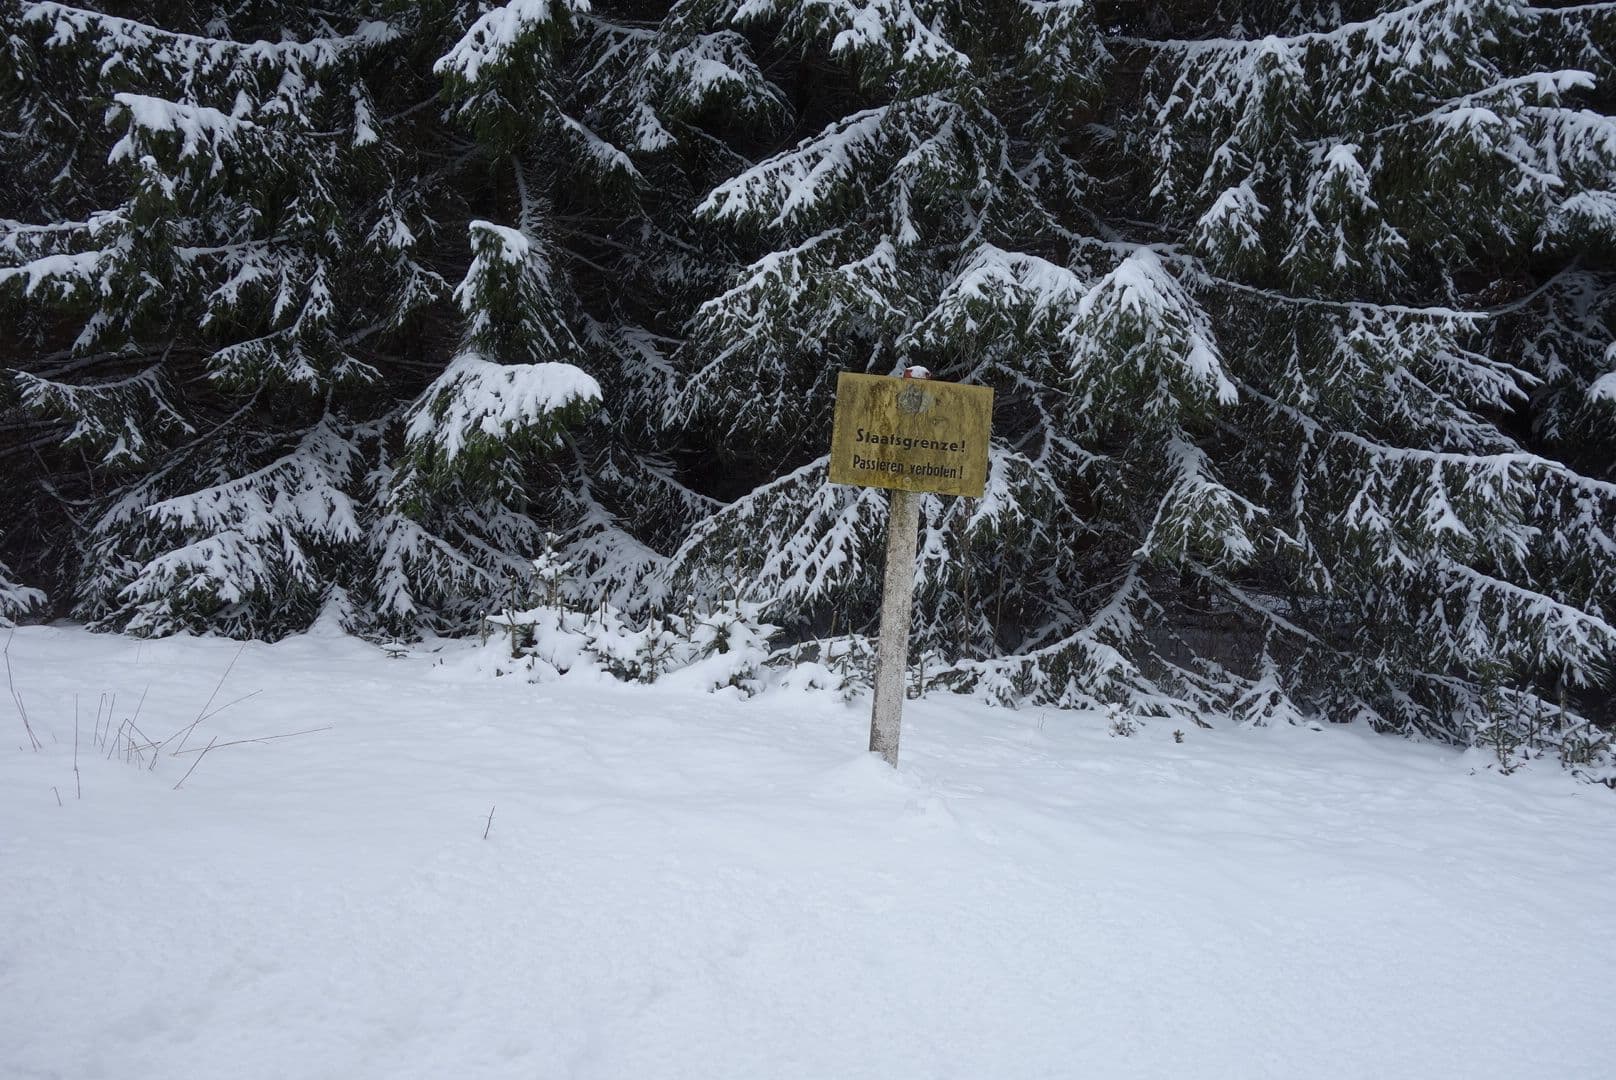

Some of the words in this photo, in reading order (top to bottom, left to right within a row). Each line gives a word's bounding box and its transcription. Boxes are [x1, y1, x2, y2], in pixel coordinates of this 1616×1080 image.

[856, 428, 965, 453] Staatsgrenze!
[853, 454, 904, 473] Passieren
[910, 462, 963, 479] verboten!
